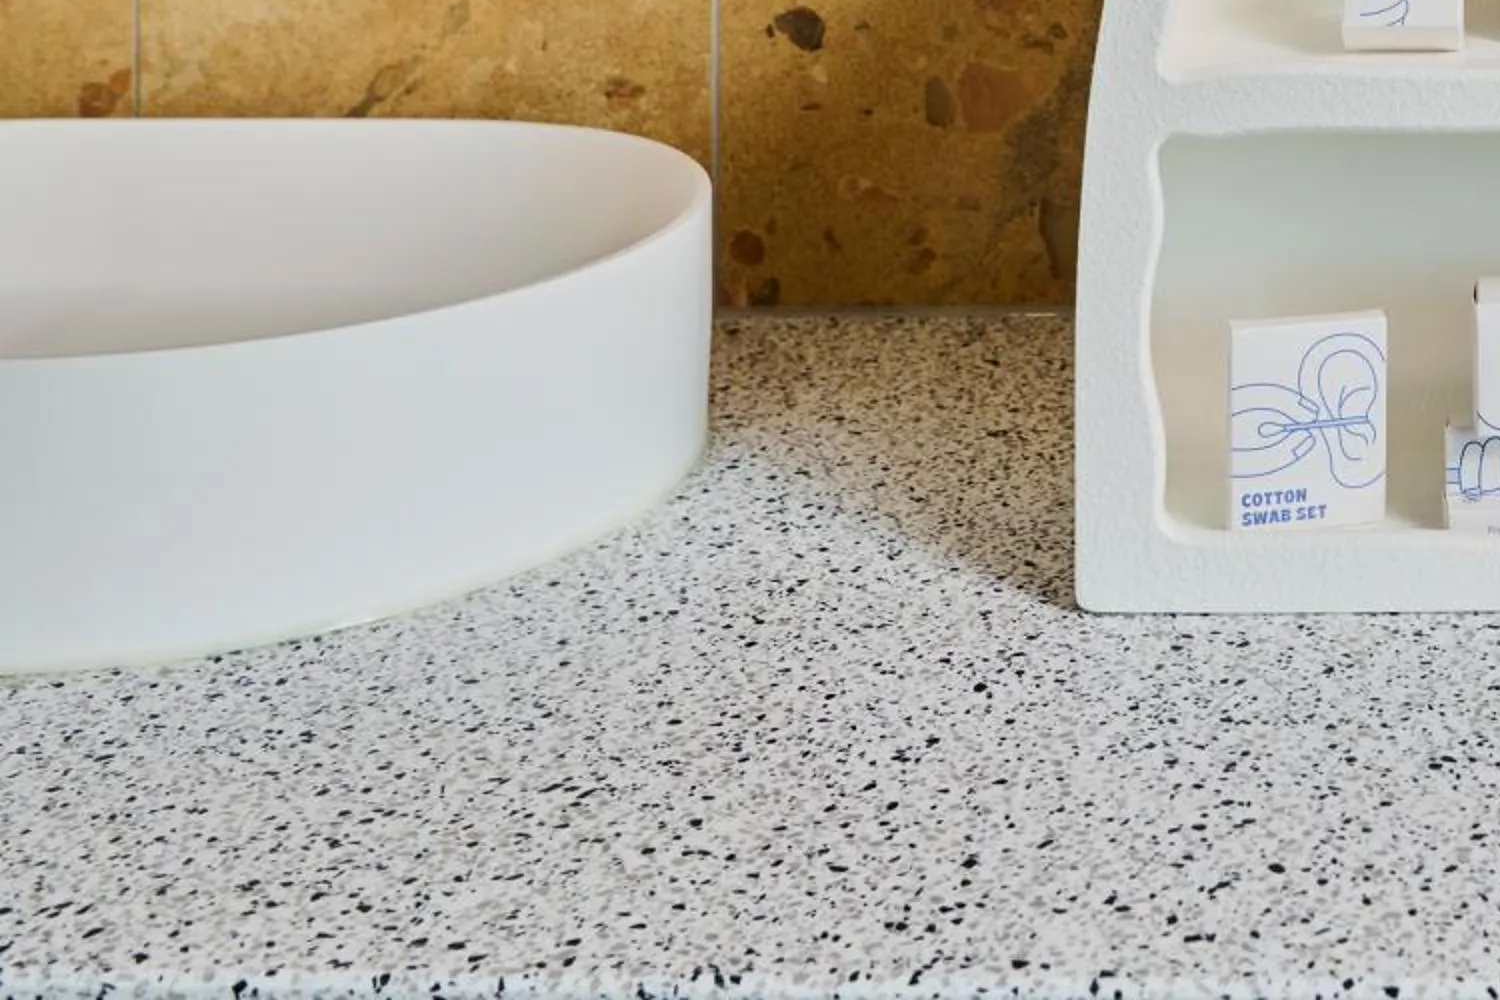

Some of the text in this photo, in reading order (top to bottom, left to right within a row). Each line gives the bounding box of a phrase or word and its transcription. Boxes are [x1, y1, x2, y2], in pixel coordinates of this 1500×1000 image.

[1241, 487, 1308, 508] COTTON
[1241, 504, 1327, 527] SWAB SET
